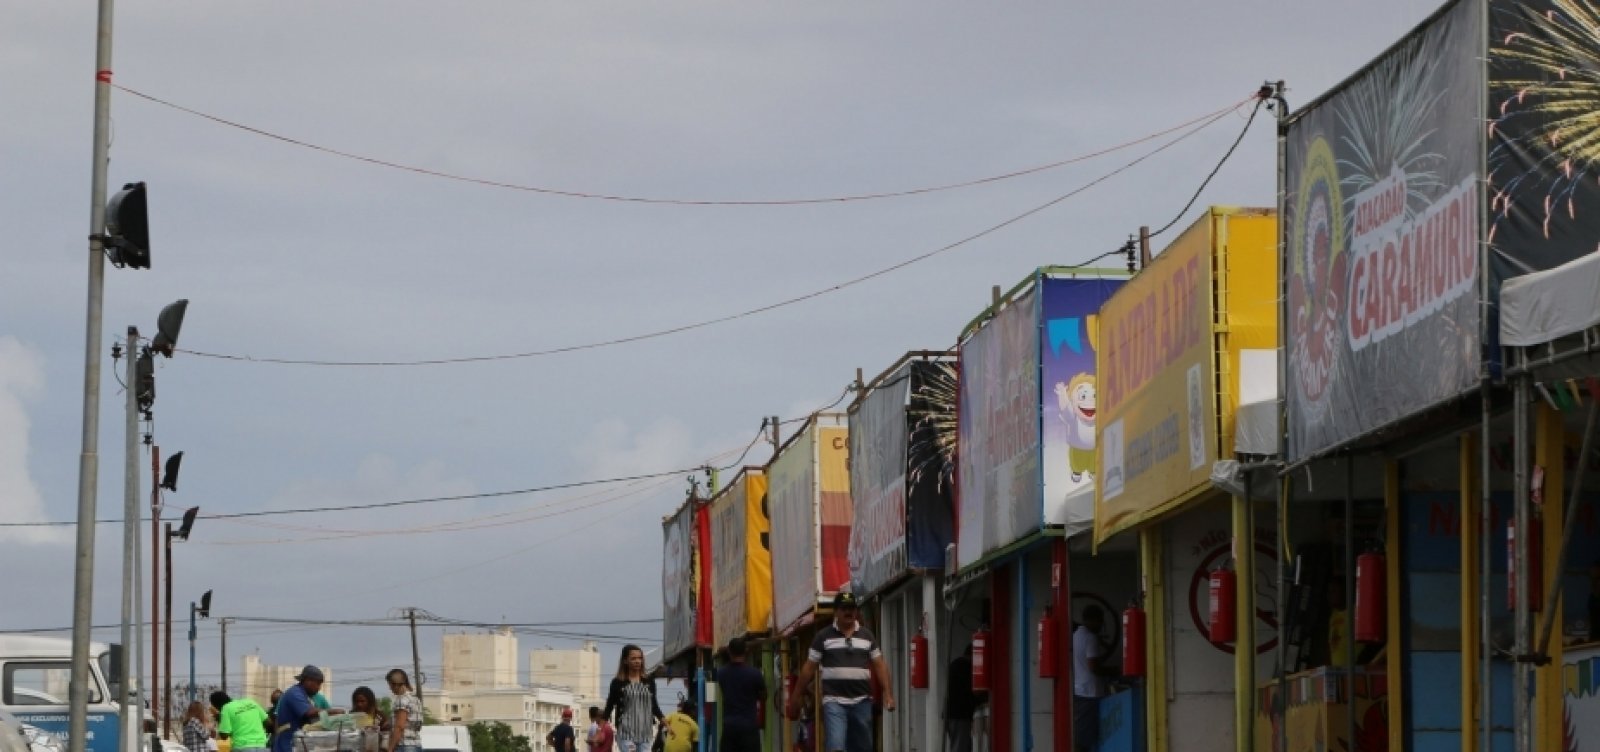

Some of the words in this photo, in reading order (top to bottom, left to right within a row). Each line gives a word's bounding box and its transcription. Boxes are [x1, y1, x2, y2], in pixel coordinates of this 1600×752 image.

[1350, 182, 1477, 341] CARAMURU
[1355, 177, 1404, 237] ATACADÃO
[1103, 253, 1200, 414] ANDRADE
